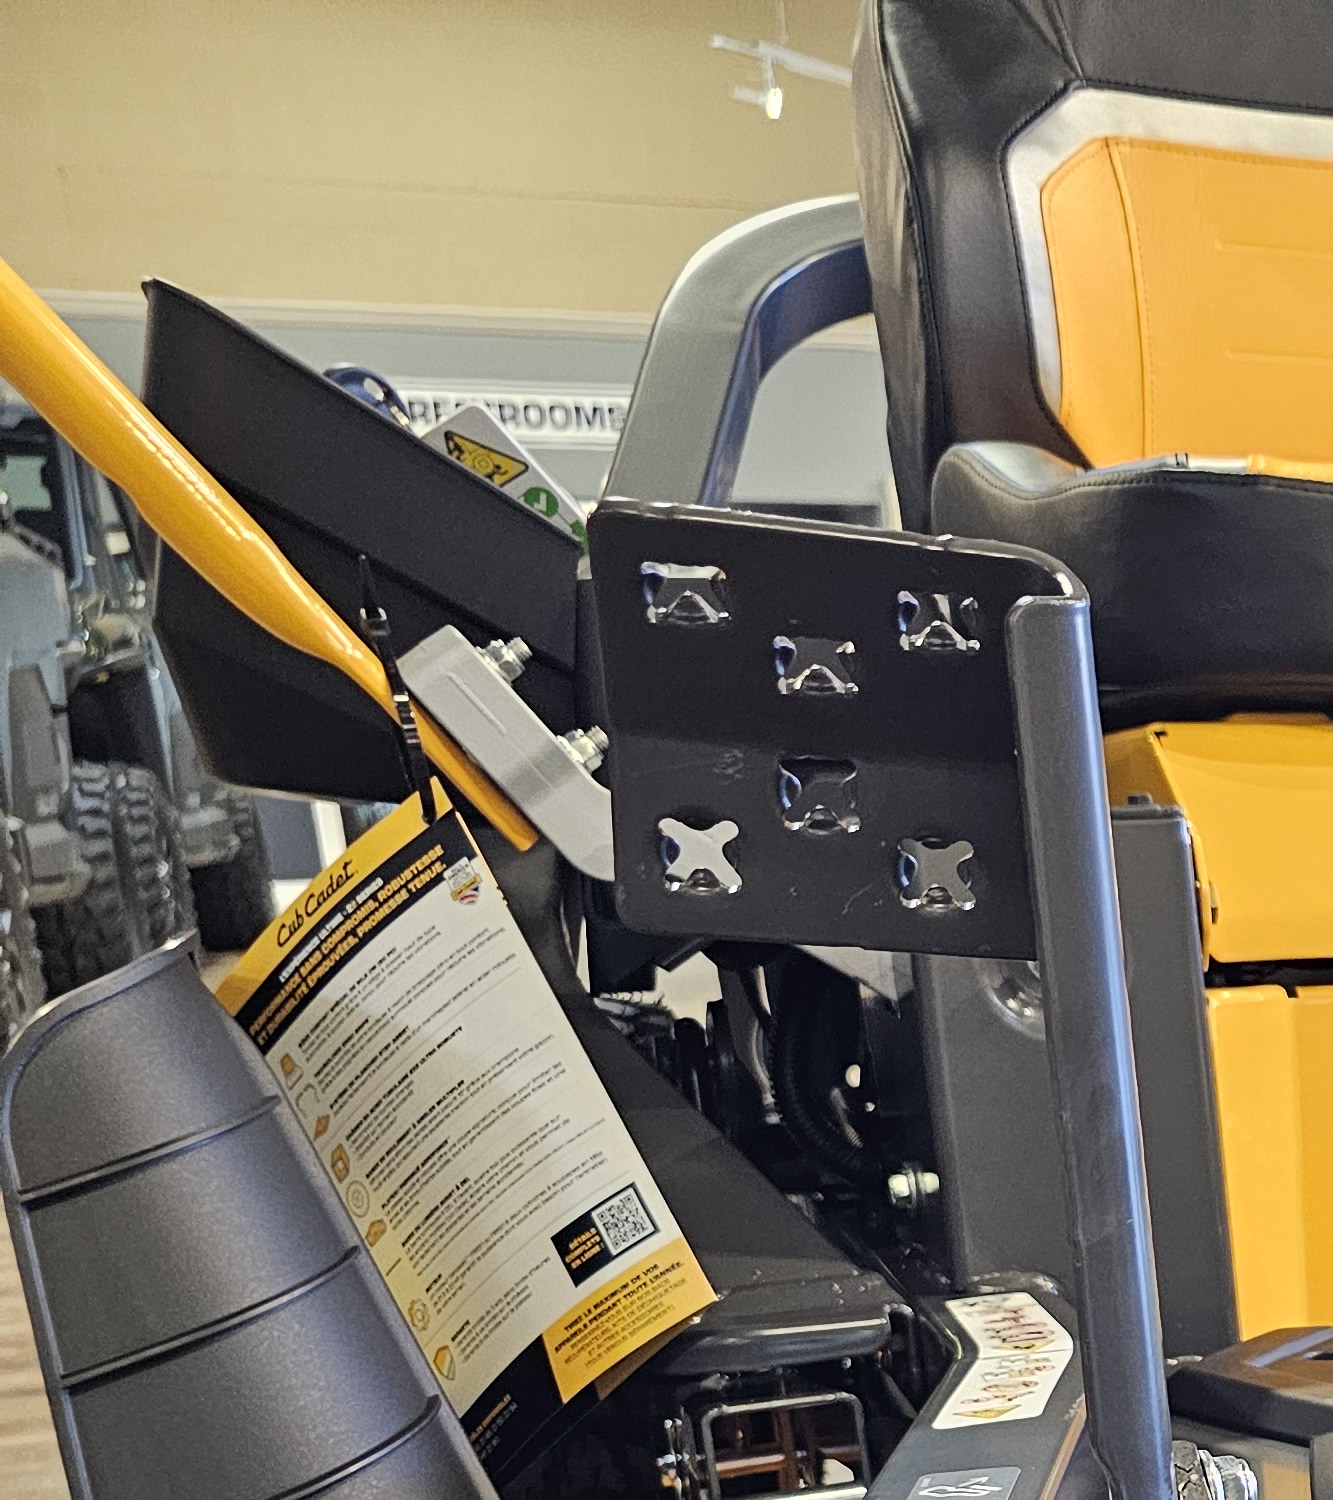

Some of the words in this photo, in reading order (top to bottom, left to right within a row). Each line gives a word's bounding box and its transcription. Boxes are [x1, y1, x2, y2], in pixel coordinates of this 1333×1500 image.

[407, 400, 627, 430] REROOMS
[376, 844, 443, 902] ROBUSTESSE
[406, 860, 446, 892] TENUE.
[275, 908, 304, 948] Cub
[303, 859, 354, 917] Cadet
[630, 1273, 641, 1284] DE
[642, 1262, 659, 1277] VOS
[622, 1280, 648, 1300] TOUTE
